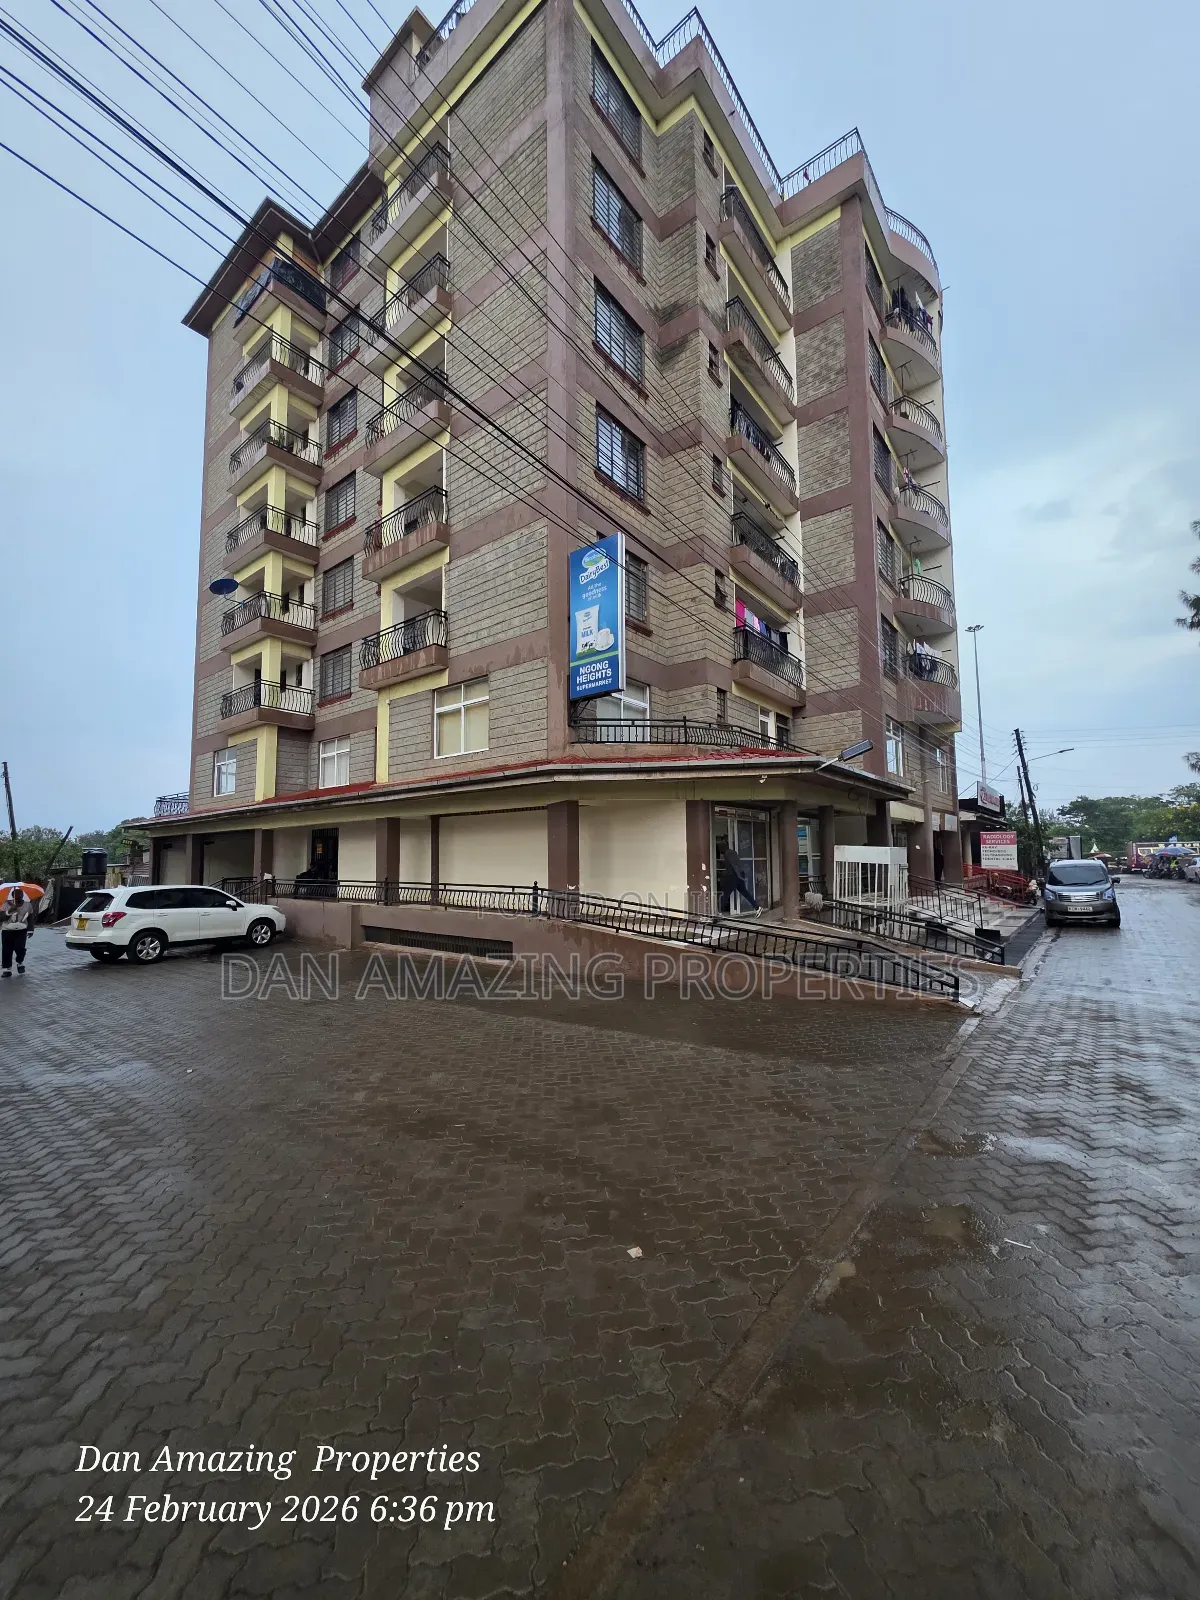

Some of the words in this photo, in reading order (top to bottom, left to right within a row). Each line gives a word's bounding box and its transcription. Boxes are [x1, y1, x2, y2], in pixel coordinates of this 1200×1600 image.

[580, 559, 609, 583] DairyBest
[581, 629, 594, 638] MILK
[579, 660, 609, 675] NGONG
[576, 668, 612, 684] HEIGHTS
[576, 678, 612, 692] SUPERMARKET
